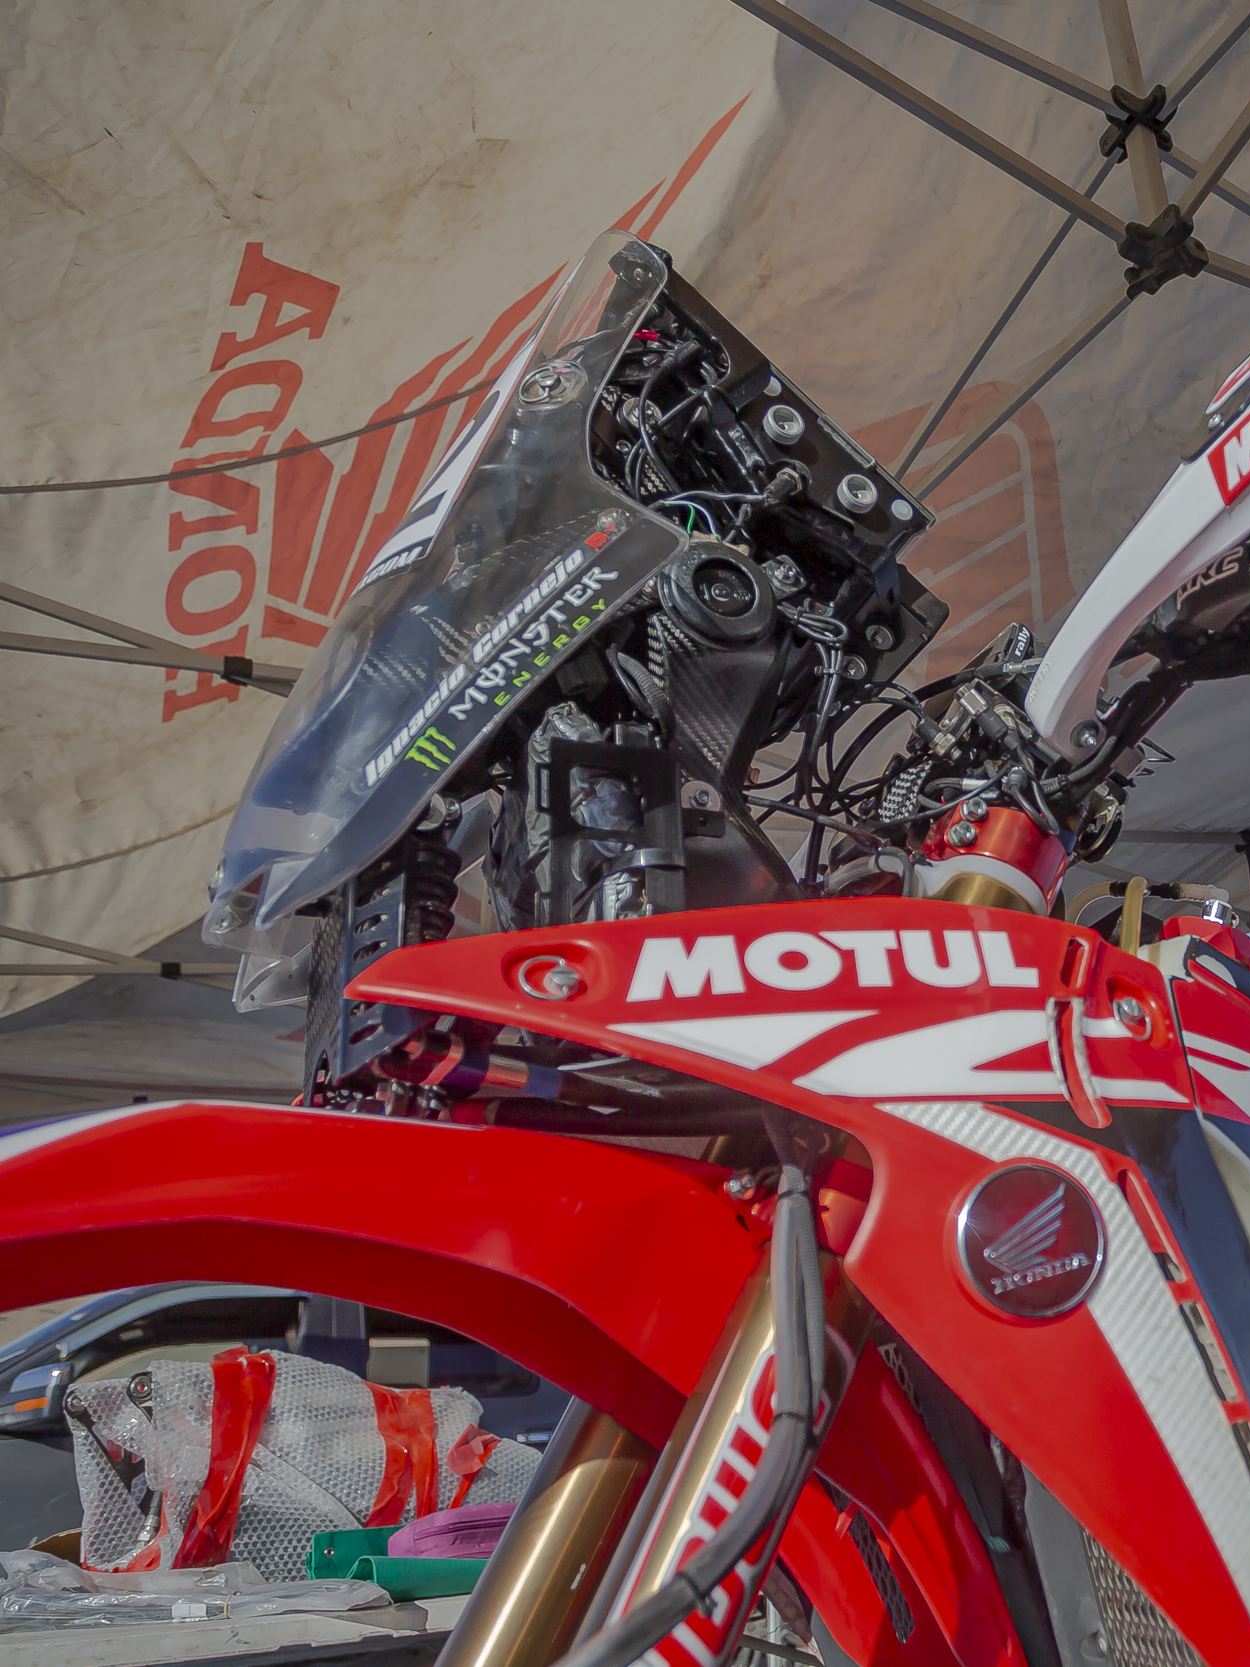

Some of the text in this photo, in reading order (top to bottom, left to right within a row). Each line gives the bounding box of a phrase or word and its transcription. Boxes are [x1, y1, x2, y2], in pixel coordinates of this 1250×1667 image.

[363, 663, 467, 787] Ignacio
[472, 548, 584, 664] Cornejo
[494, 599, 606, 706] ENERGY
[1014, 626, 1030, 657] rally
[626, 930, 1039, 1003] MOTUL
[991, 1252, 1092, 1294] HONDA
